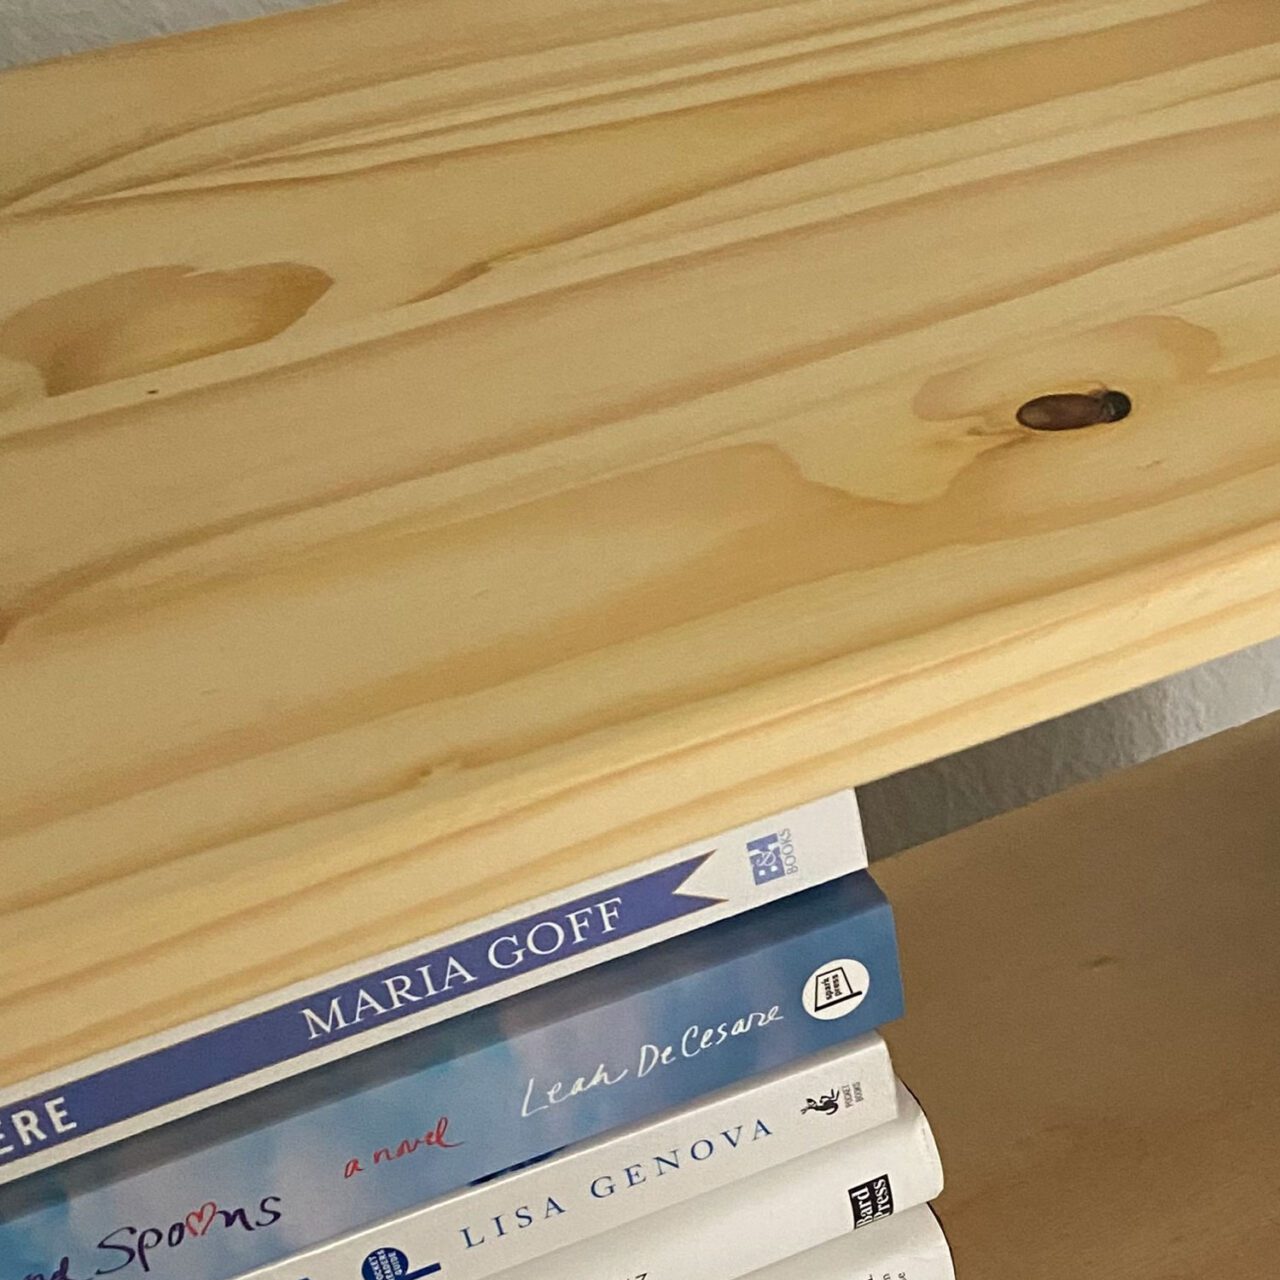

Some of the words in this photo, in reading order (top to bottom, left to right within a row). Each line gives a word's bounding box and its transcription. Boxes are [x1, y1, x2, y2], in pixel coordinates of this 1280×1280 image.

[779, 828, 799, 875] BOOKS
[300, 955, 477, 1041] MARIA
[487, 897, 623, 970] GOFF
[343, 1158, 363, 1180] a
[373, 1116, 464, 1164] novel
[521, 1066, 631, 1118] Leah
[459, 1196, 566, 1249] LISA
[590, 1118, 774, 1201] GENOVA
[851, 1186, 874, 1227] Bard
